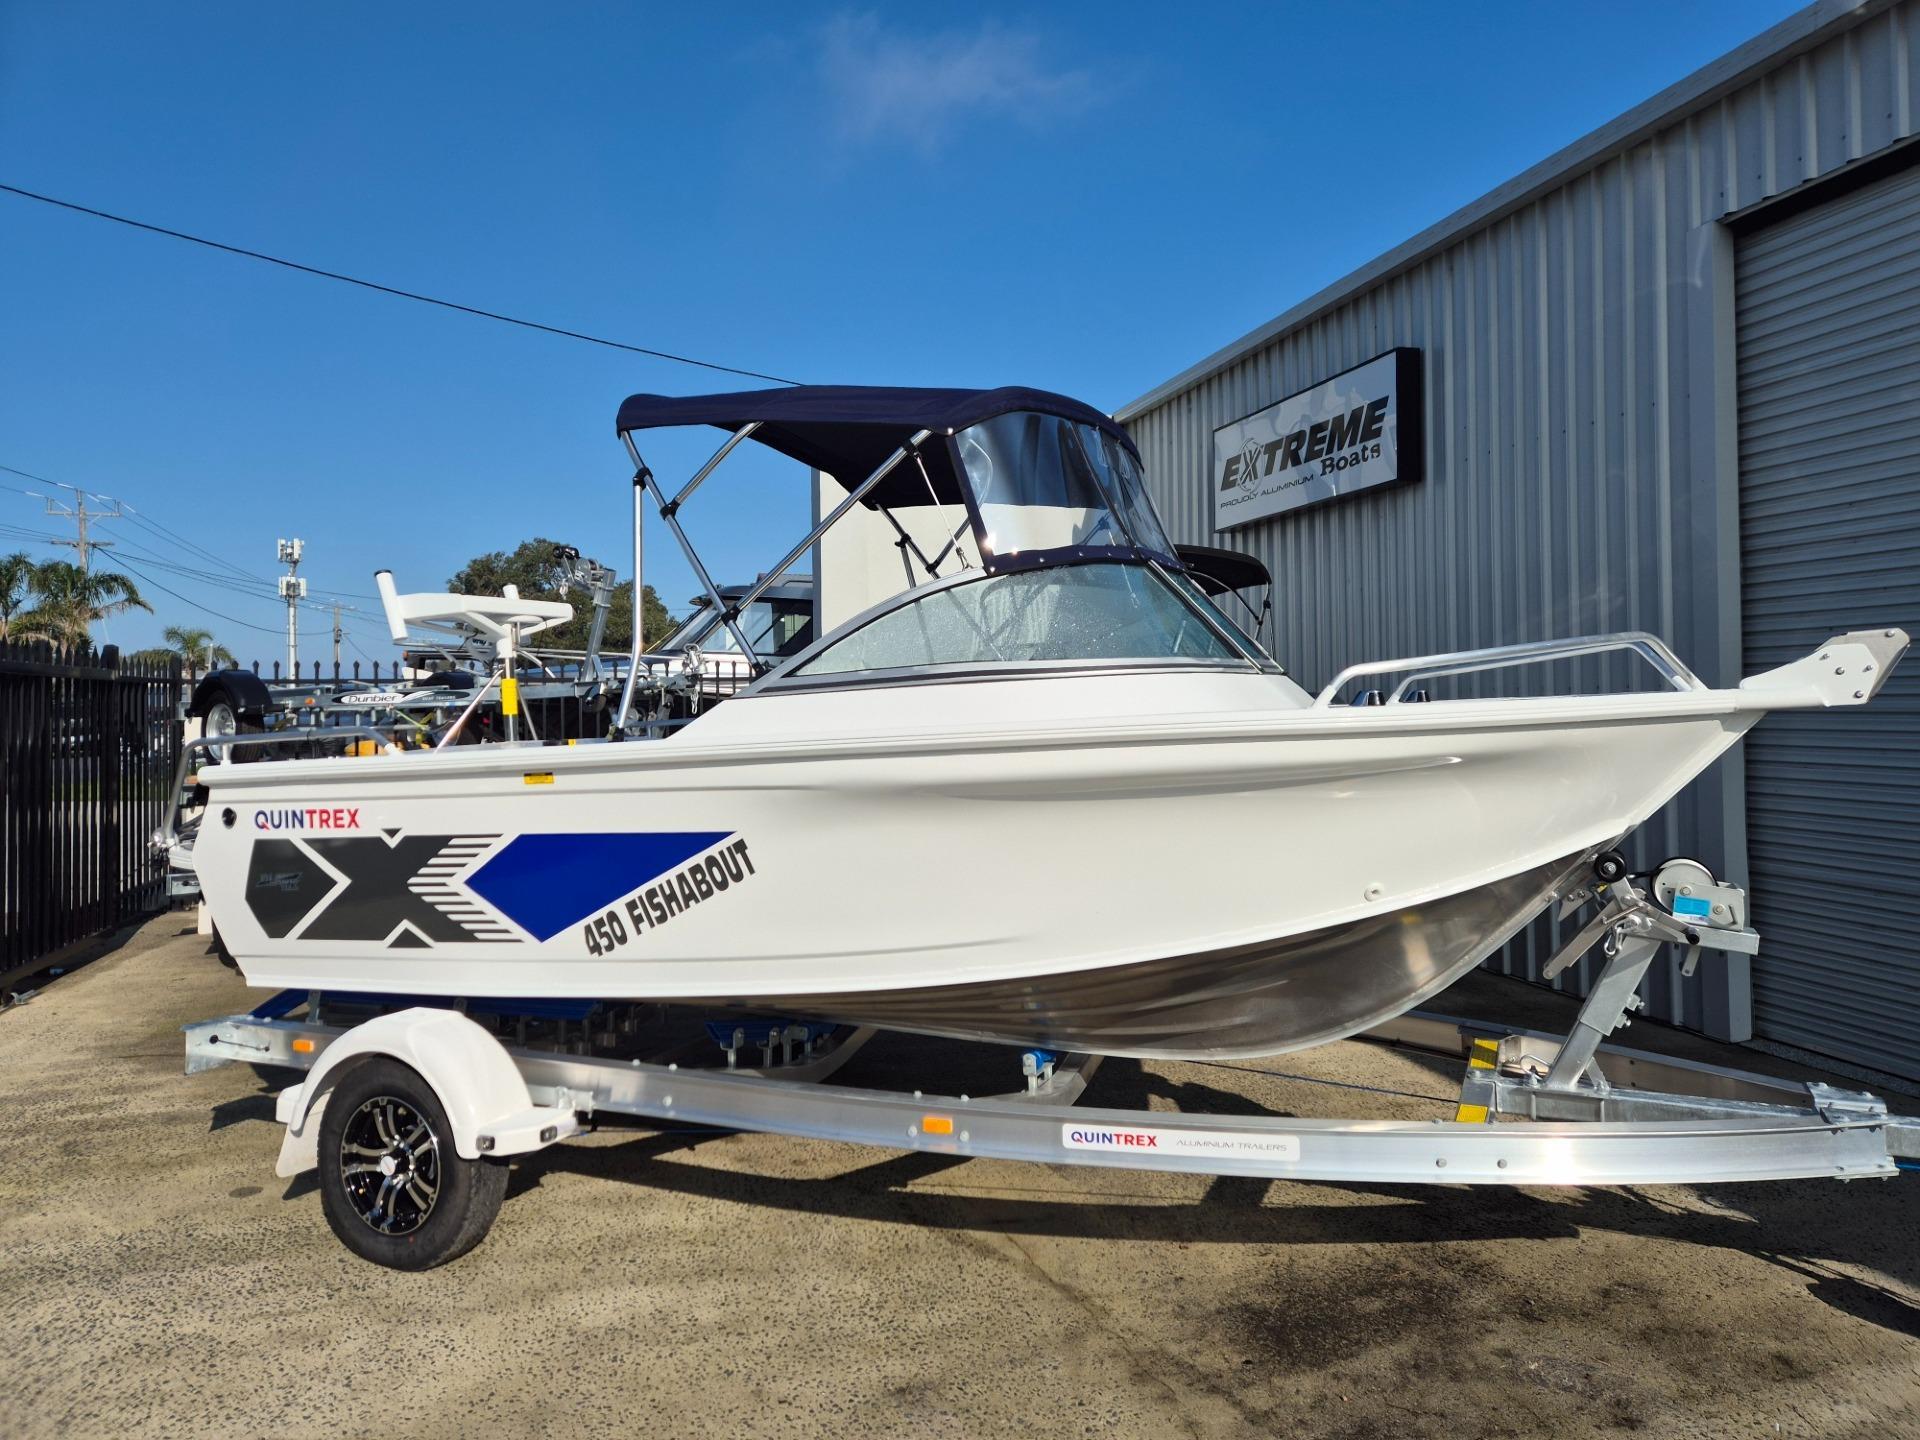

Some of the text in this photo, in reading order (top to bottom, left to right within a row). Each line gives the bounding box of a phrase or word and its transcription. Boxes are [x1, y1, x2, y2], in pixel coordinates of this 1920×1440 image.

[1221, 395, 1389, 491] EXTREME
[1320, 443, 1381, 477] Boats
[1220, 474, 1314, 509] PROUDLY ALUMINIUM
[348, 695, 397, 703] Dunbier
[254, 808, 360, 830] QUINTREX
[584, 838, 756, 957] 450 FISHABOUT
[1071, 1131, 1288, 1152] QUINTREX ALUMINIUM TRAILERS
